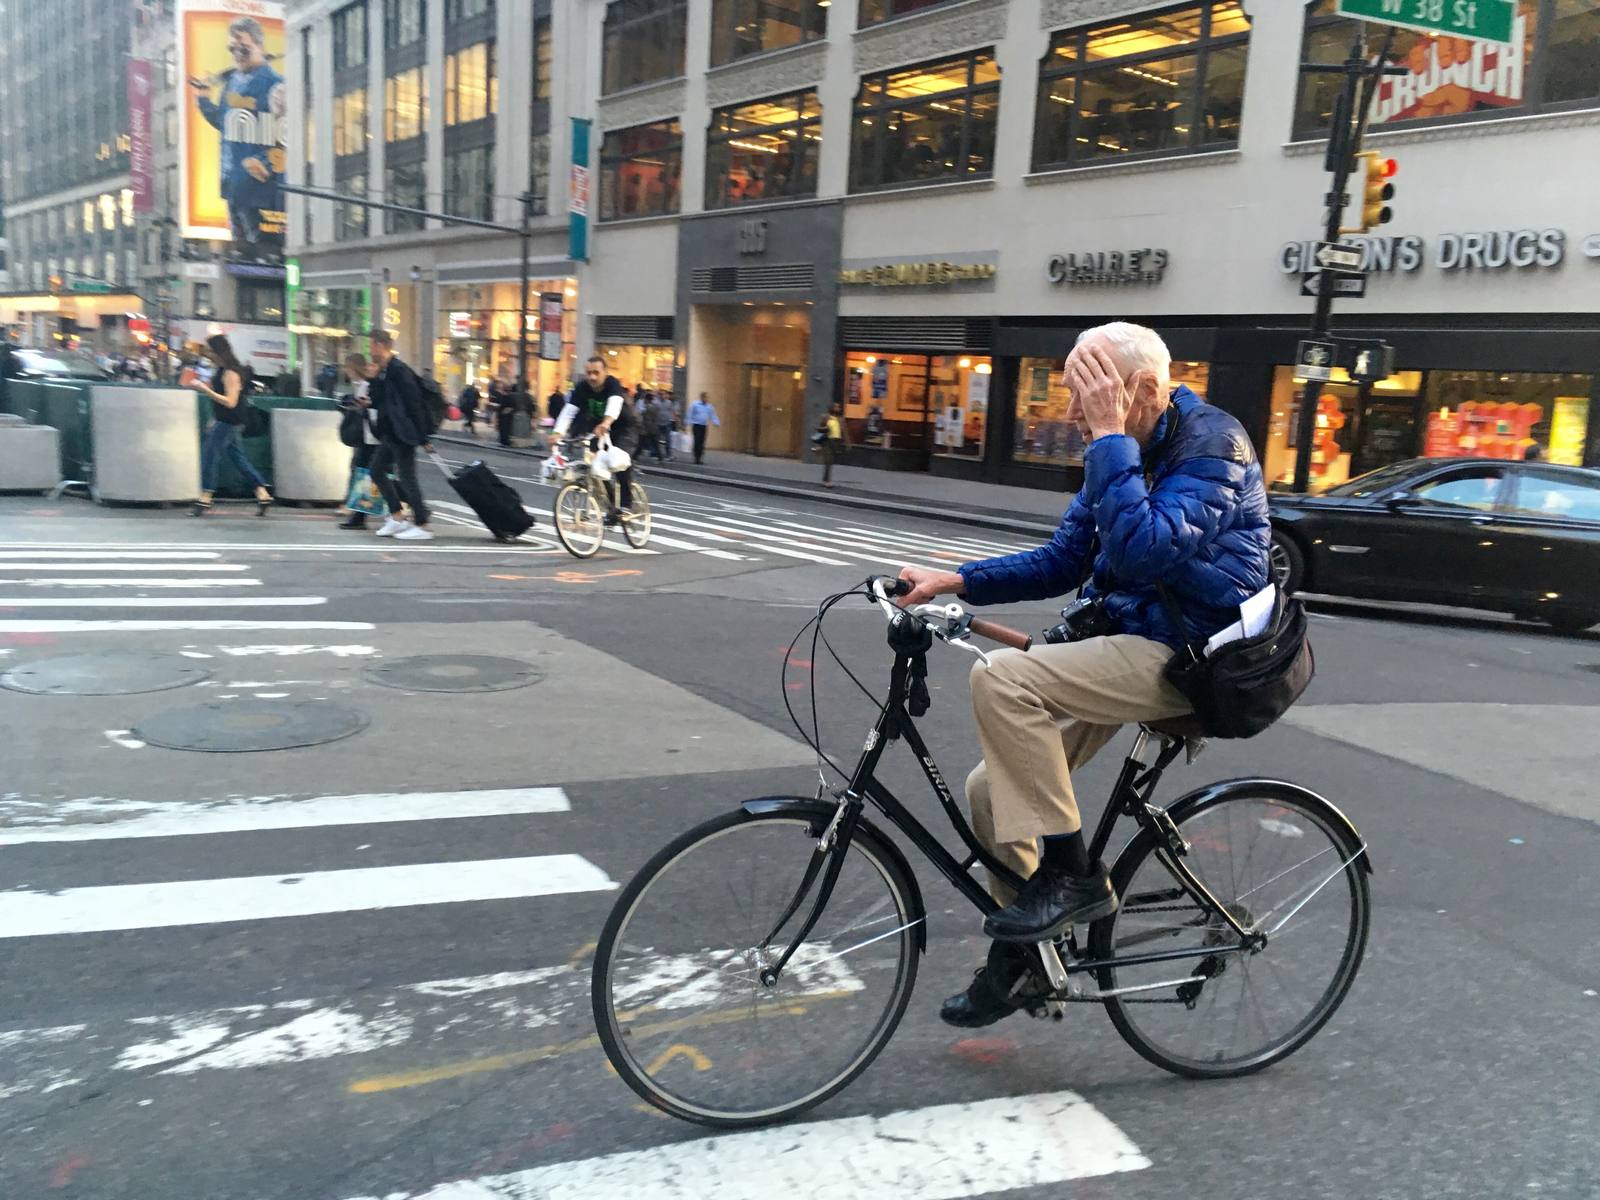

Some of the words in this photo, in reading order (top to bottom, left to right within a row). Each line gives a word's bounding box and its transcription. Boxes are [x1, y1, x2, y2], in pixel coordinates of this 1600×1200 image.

[1413, 0, 1443, 22] 38
[1451, 0, 1478, 29] St
[1435, 229, 1564, 270] DRUGS
